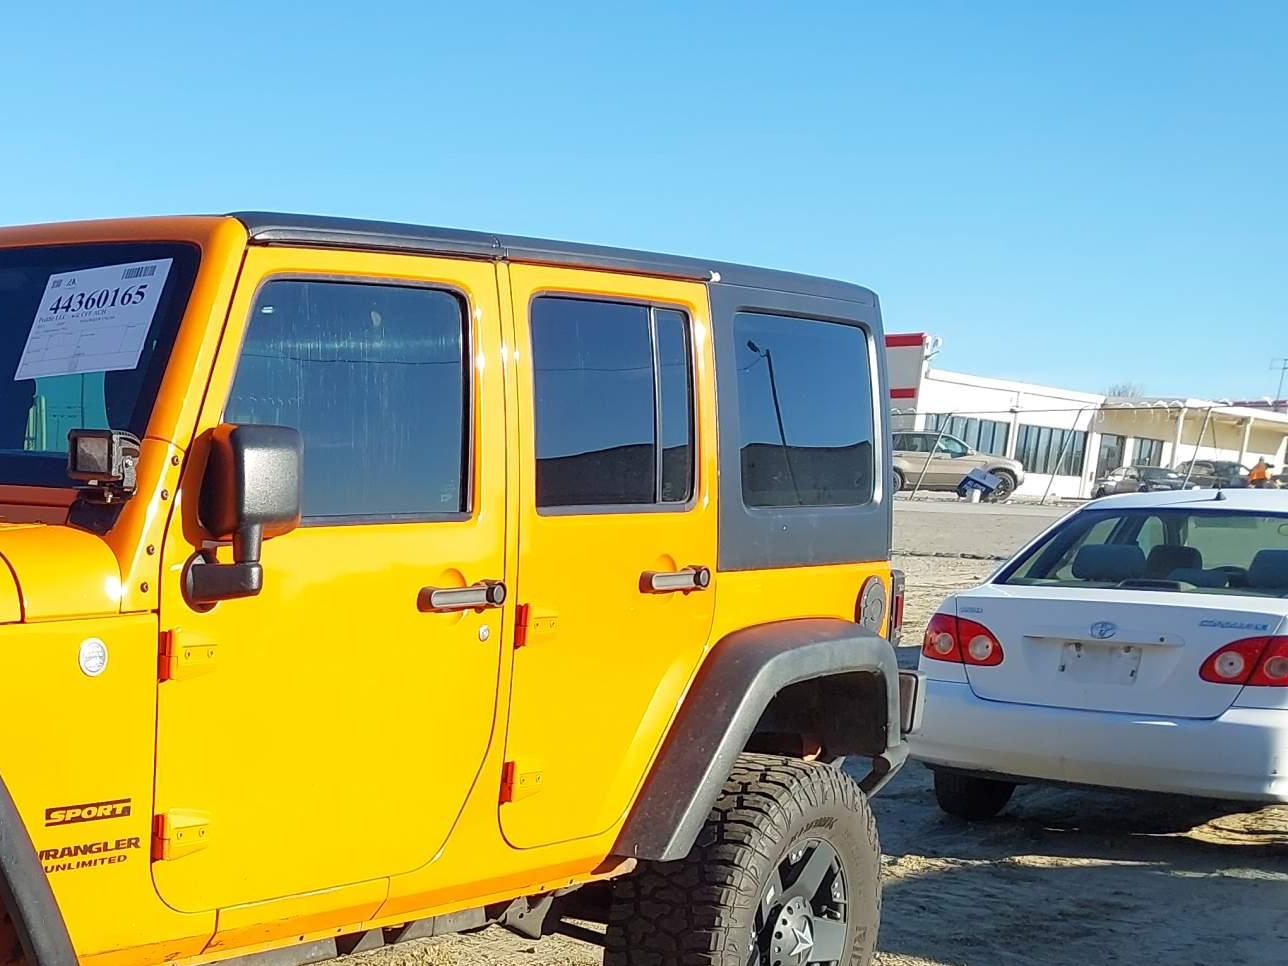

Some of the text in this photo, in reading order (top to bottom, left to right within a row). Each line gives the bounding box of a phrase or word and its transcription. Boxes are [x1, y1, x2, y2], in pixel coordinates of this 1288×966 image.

[49, 284, 148, 315] 44360165
[49, 802, 131, 823] SPORT
[44, 855, 127, 874] UNLIMITED
